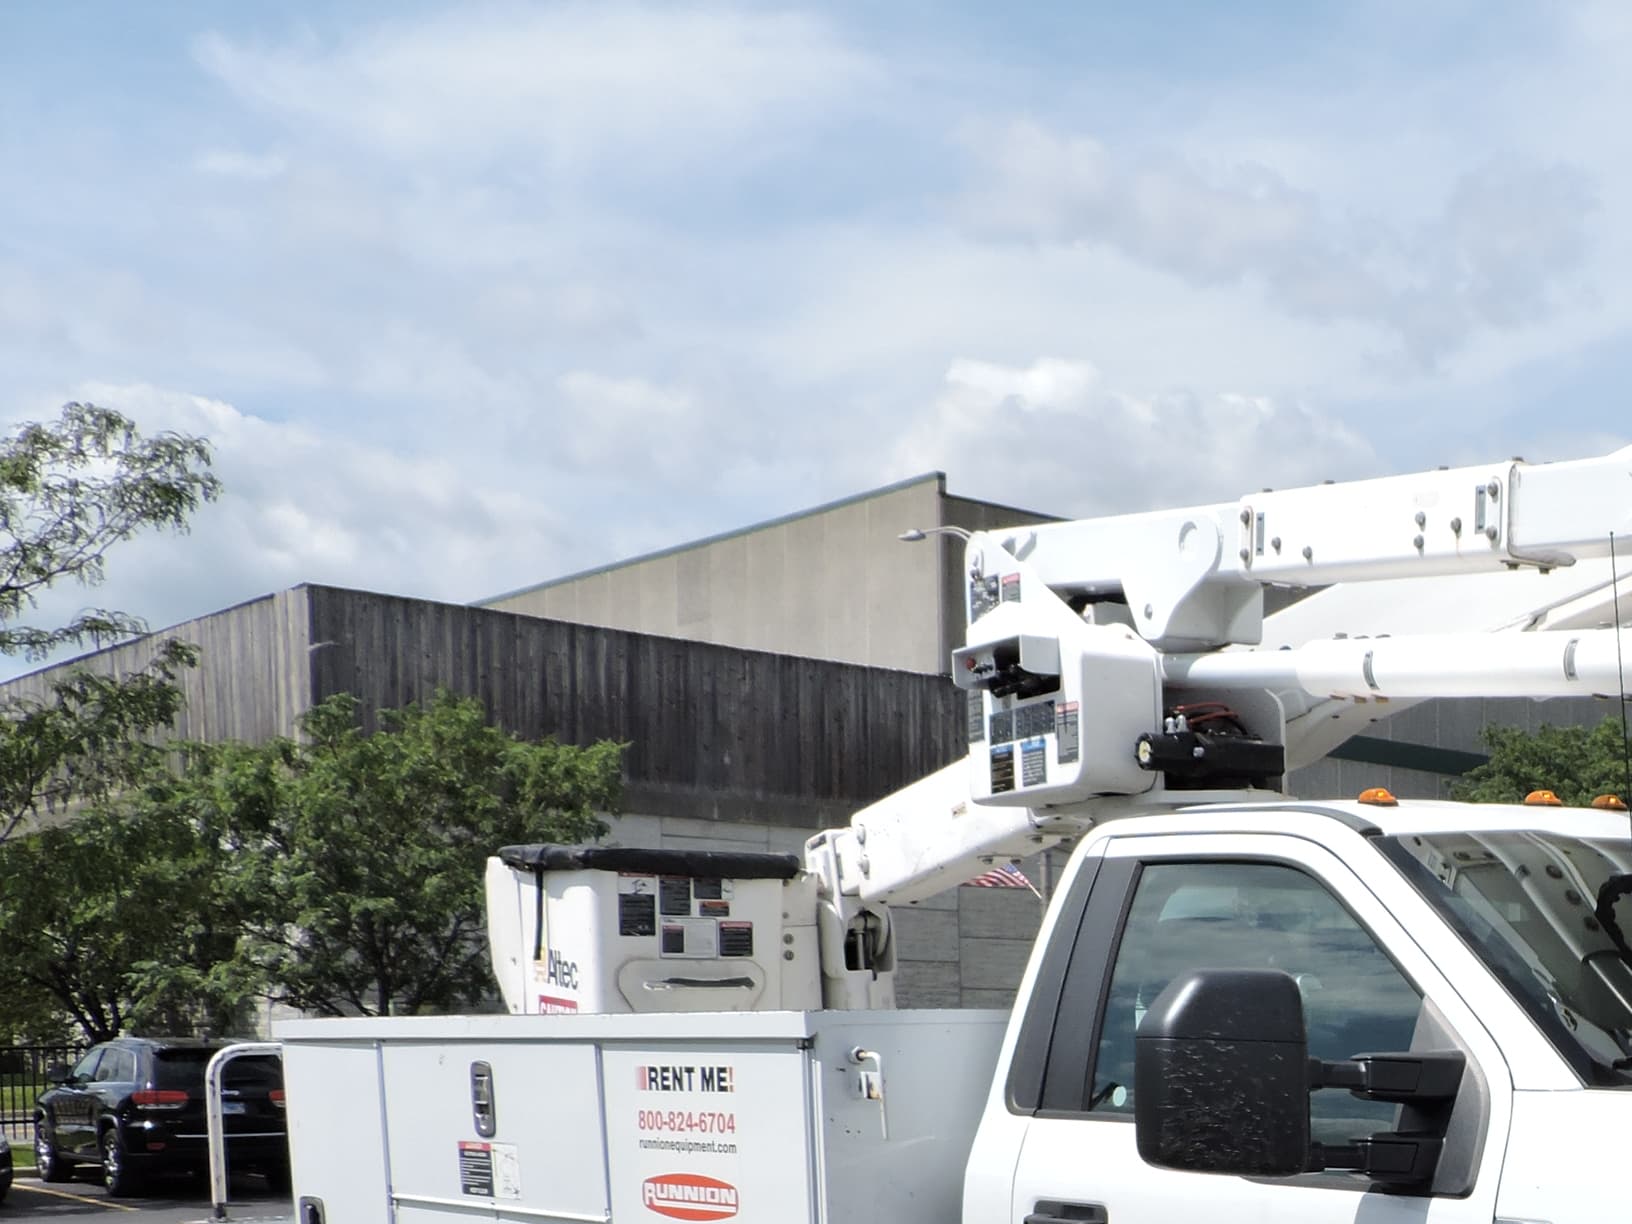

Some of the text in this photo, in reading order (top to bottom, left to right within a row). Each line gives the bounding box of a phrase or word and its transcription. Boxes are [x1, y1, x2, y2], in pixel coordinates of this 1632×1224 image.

[547, 948, 578, 990] Altec
[648, 1066, 735, 1093] RENT ME!
[638, 1110, 736, 1135] 800-824-6704
[639, 1137, 738, 1156] runnionequipment.com
[643, 1181, 738, 1213] RUNNION
